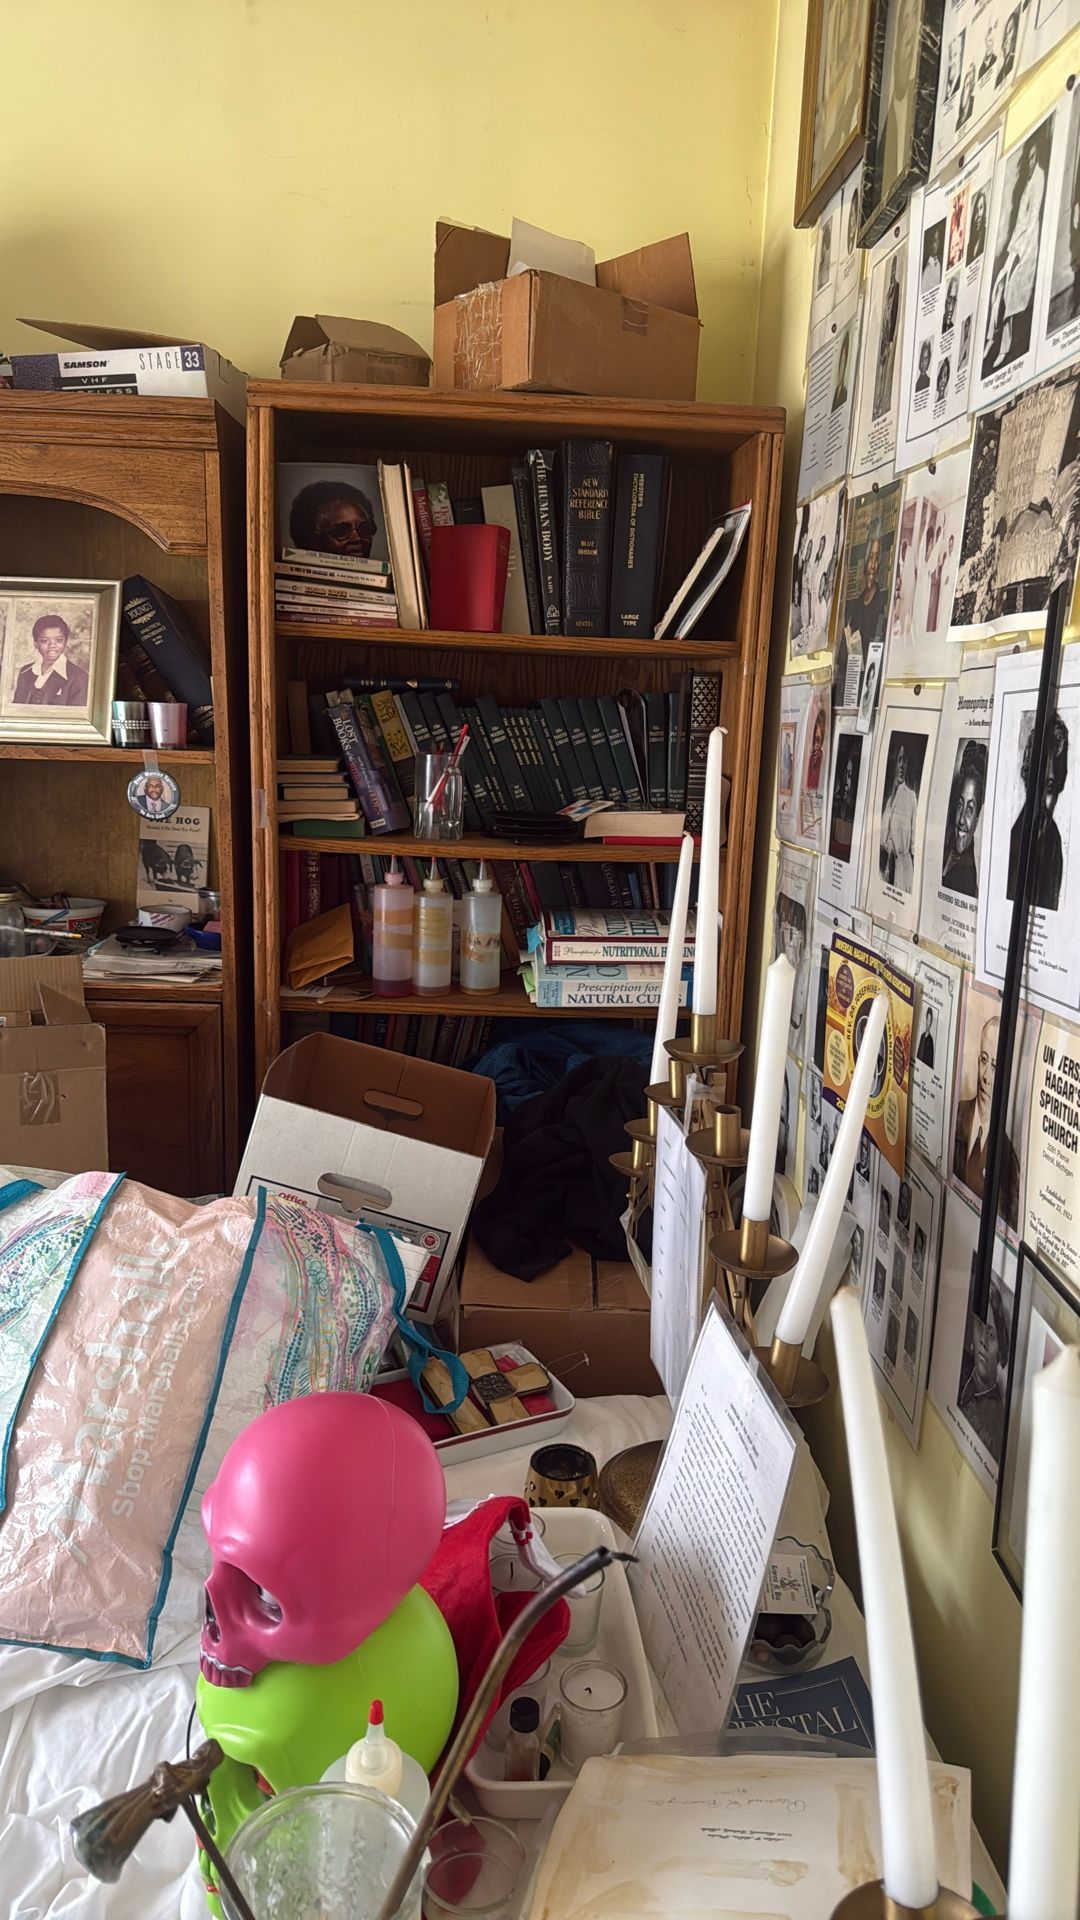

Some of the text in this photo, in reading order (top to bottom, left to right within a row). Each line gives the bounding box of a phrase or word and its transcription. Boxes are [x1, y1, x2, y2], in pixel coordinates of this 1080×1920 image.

[63, 360, 107, 369] SAMSON
[139, 351, 200, 371] STAGE 33
[536, 455, 548, 482] THE
[572, 488, 609, 499] STANDARD
[582, 477, 599, 488] NEW
[538, 483, 550, 529] HUMAN
[569, 498, 609, 509] REFERENCE
[630, 473, 639, 518] ENCYCLOPEDIA
[578, 509, 601, 520] BIBLE
[541, 530, 553, 562] BODY
[627, 528, 635, 569] DICTIONARIES
[621, 613, 640, 621] LARGE
[333, 717, 351, 751] BOOKS
[342, 719, 358, 744] LOST
[176, 816, 200, 825] HOG
[563, 946, 593, 956] Prescription
[602, 946, 660, 958] NUTRITIONAL
[567, 993, 633, 1004] NATURAL
[577, 982, 660, 994] Prescription for
[1044, 1069, 1080, 1108] HAGAR'S
[1040, 1089, 1080, 1133] SPIRITUA
[1042, 1114, 1078, 1154] CHURCH
[1055, 1159, 1074, 1178] Michigan
[278, 1192, 307, 1207] Office
[1039, 1189, 1056, 1209] September
[1062, 1209, 1073, 1222] 1923
[1045, 1185, 1066, 1207] Established
[50, 1237, 191, 1563] Marshalls
[111, 1267, 206, 1518] Shop Marshalls.com
[731, 1690, 781, 1720] HE
